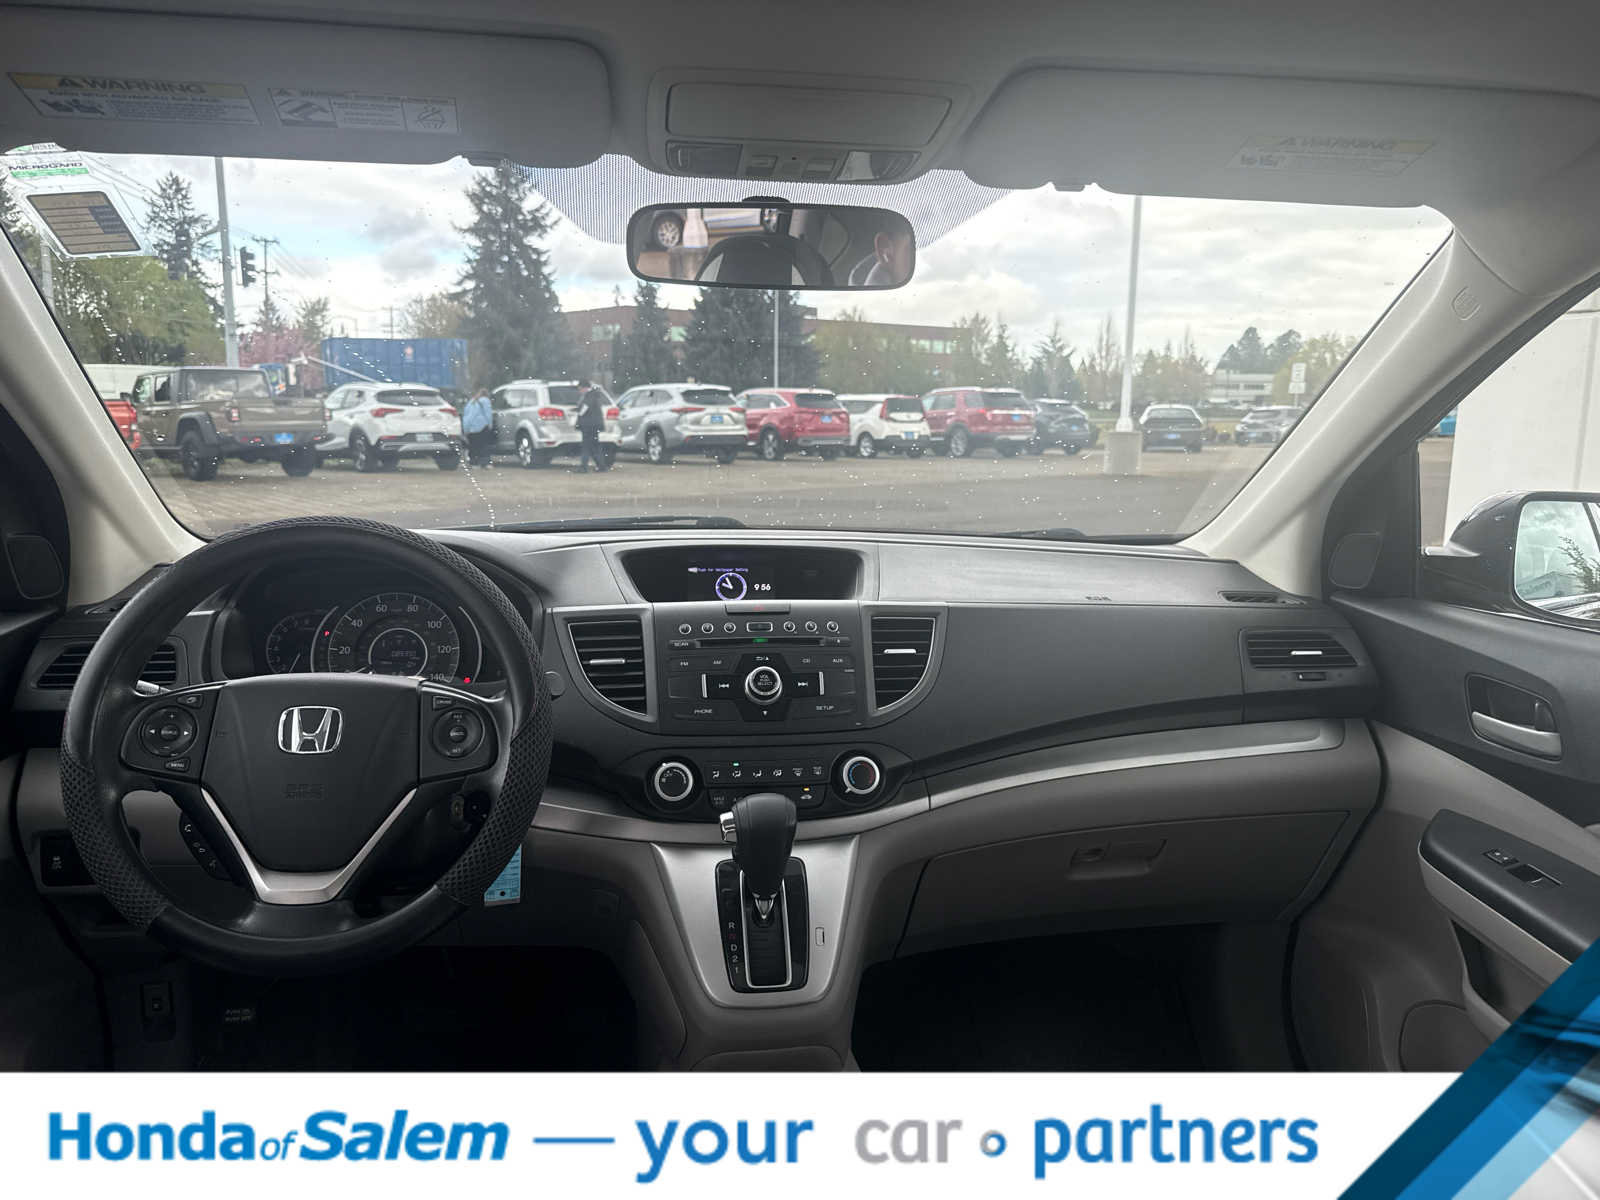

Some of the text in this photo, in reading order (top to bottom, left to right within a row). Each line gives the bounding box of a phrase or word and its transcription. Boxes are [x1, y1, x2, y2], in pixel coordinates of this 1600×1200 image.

[82, 77, 207, 94] WARNING
[375, 604, 388, 613] 60
[407, 603, 418, 613] 80
[350, 618, 363, 628] 40
[427, 620, 442, 629] 100
[338, 646, 351, 655] 20
[437, 645, 451, 654] 120
[730, 944, 738, 952] D
[732, 955, 739, 963] 2
